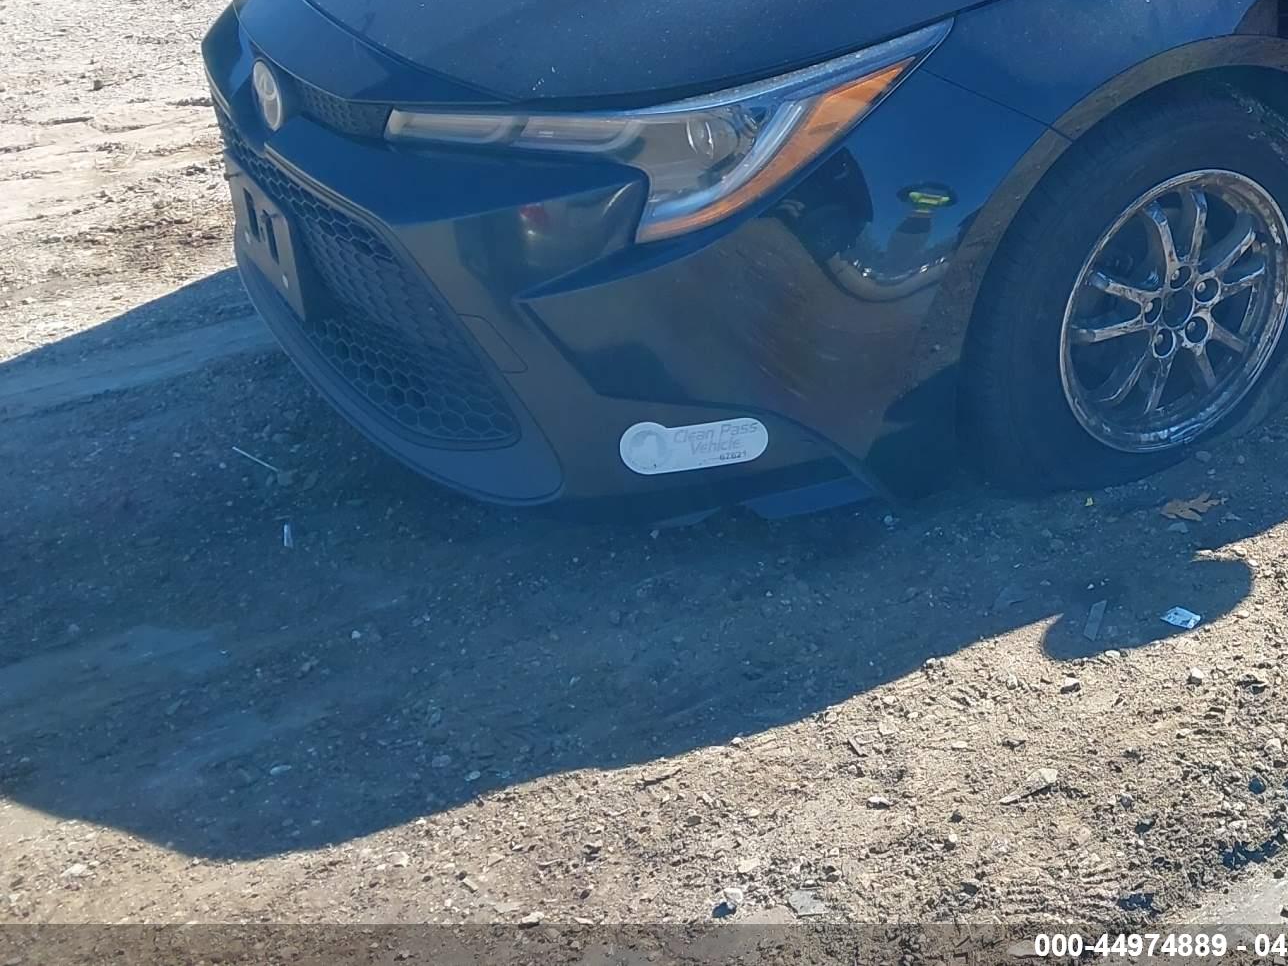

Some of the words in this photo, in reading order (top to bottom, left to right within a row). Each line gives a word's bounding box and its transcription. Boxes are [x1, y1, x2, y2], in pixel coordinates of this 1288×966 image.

[674, 429, 714, 443] Clean
[721, 423, 758, 435] Pass
[691, 437, 744, 455] Vehicle
